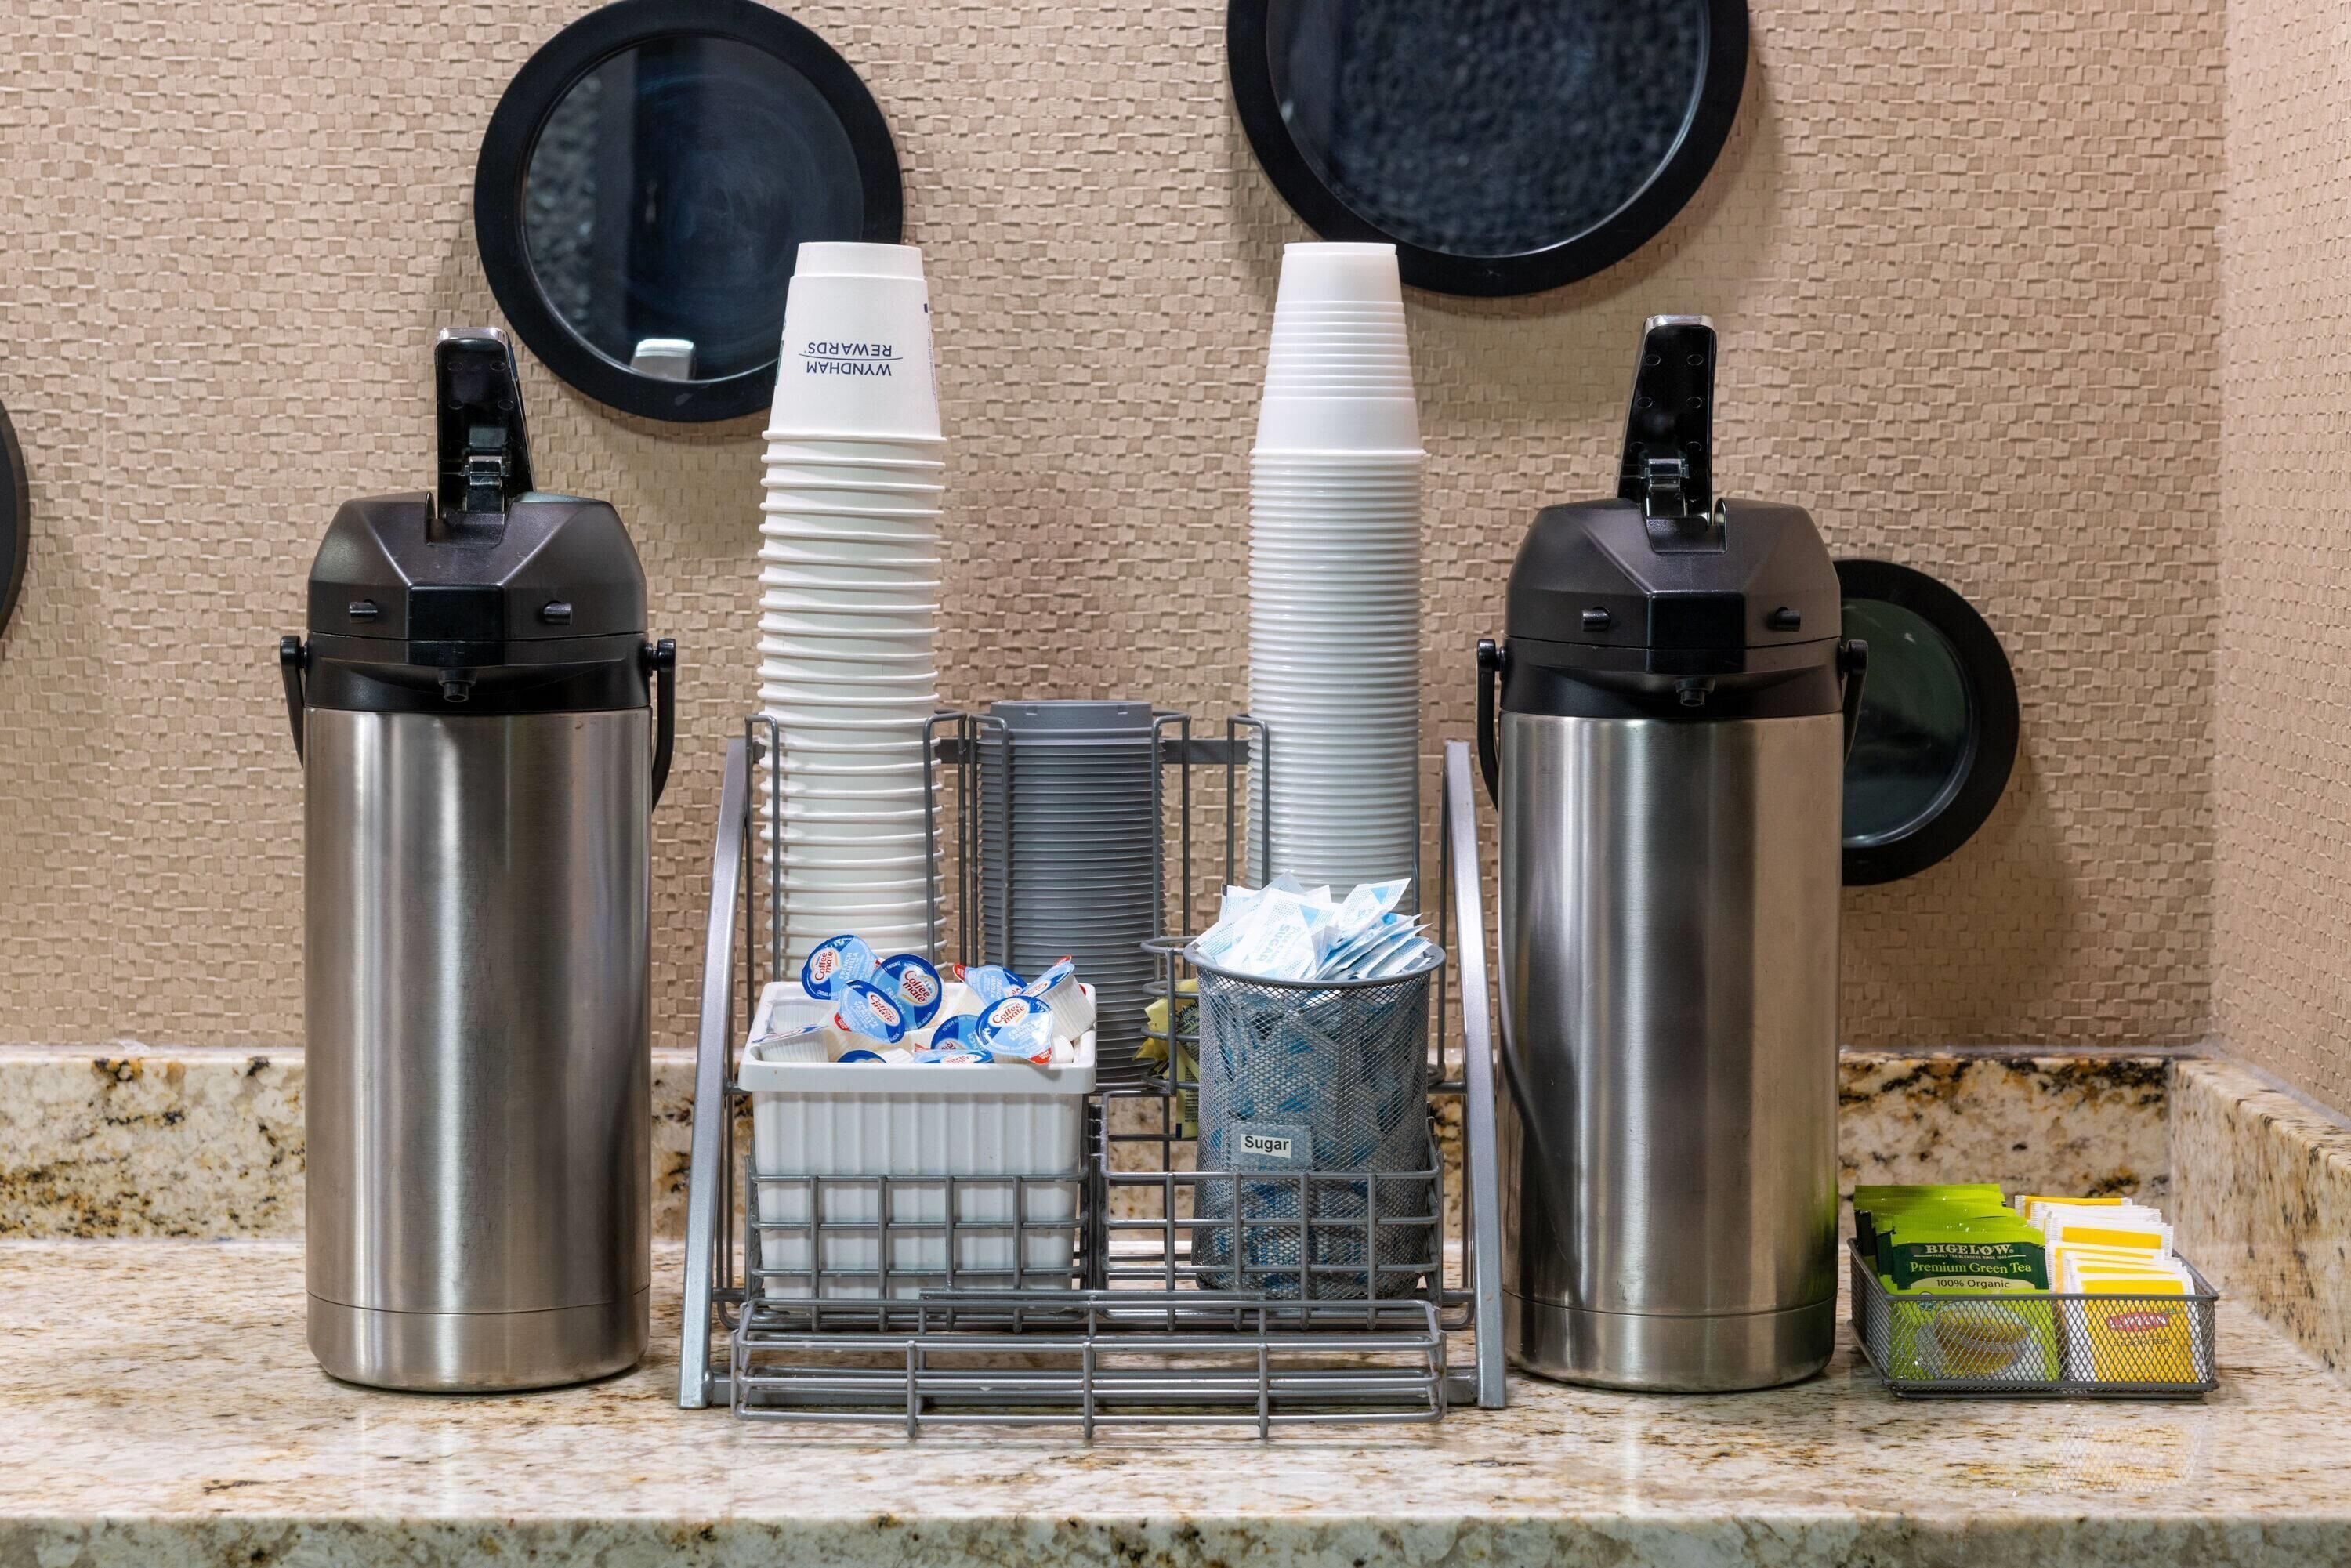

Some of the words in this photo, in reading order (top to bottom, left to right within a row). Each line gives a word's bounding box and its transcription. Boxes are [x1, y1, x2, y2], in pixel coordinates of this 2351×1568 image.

[808, 342, 892, 357] REWARDS
[806, 361, 892, 376] WYNDHAM
[1258, 925, 1291, 961] SUGAR
[815, 952, 827, 981] Coffee
[839, 952, 852, 980] FRENCH
[844, 952, 859, 980] VANILLA
[902, 981, 925, 1003] mate
[904, 970, 930, 998] Coffee
[870, 994, 895, 1020] Coffee
[886, 987, 906, 1014] FRENCH
[871, 1001, 893, 1023] mate
[992, 1003, 1020, 1024] Coffee
[1003, 1005, 1025, 1024] mate
[1244, 1135, 1289, 1153] Sugar
[1925, 1244, 2011, 1255] BIGELOW
[1911, 1262, 1967, 1273] Premium
[1969, 1263, 2009, 1273] Green
[2009, 1262, 2032, 1273] Tea
[1936, 1279, 1965, 1287] 100%
[1967, 1280, 2010, 1289] Organic
